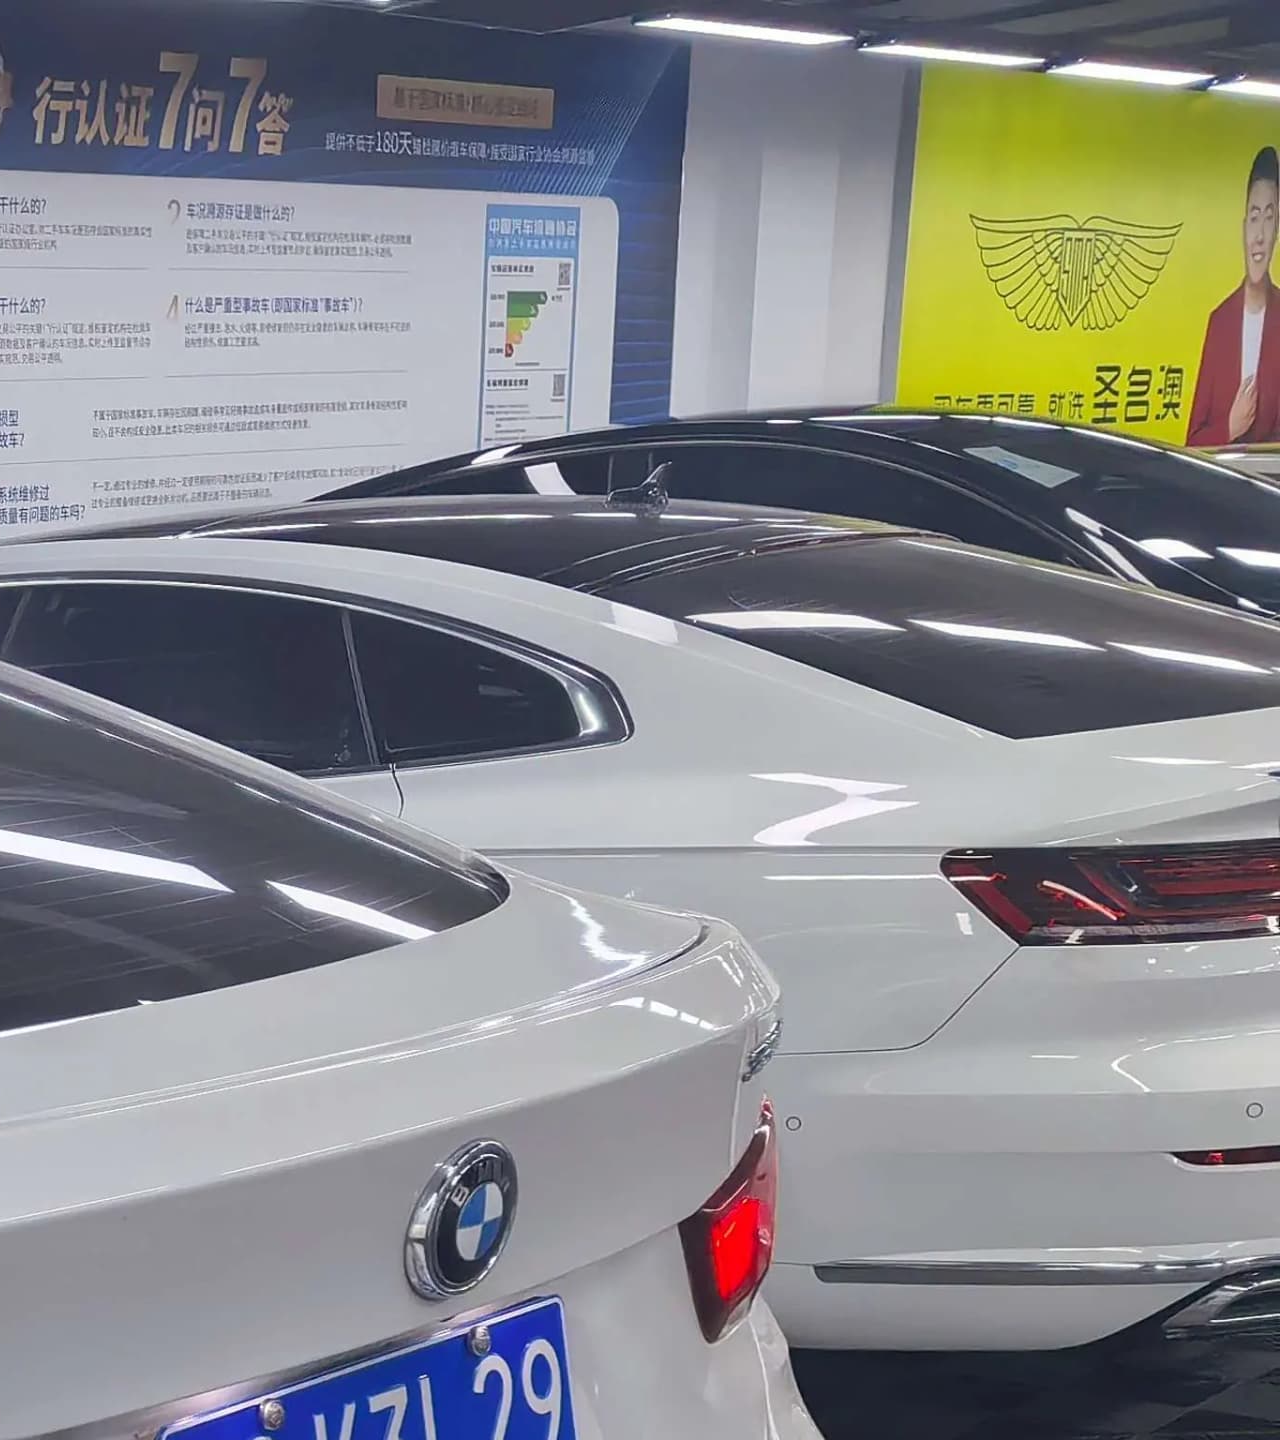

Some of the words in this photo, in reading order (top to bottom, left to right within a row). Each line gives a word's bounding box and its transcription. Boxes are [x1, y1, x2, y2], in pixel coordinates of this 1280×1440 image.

[33, 51, 293, 156] 行认证7问7答
[1091, 364, 1184, 424] 圣名澳
